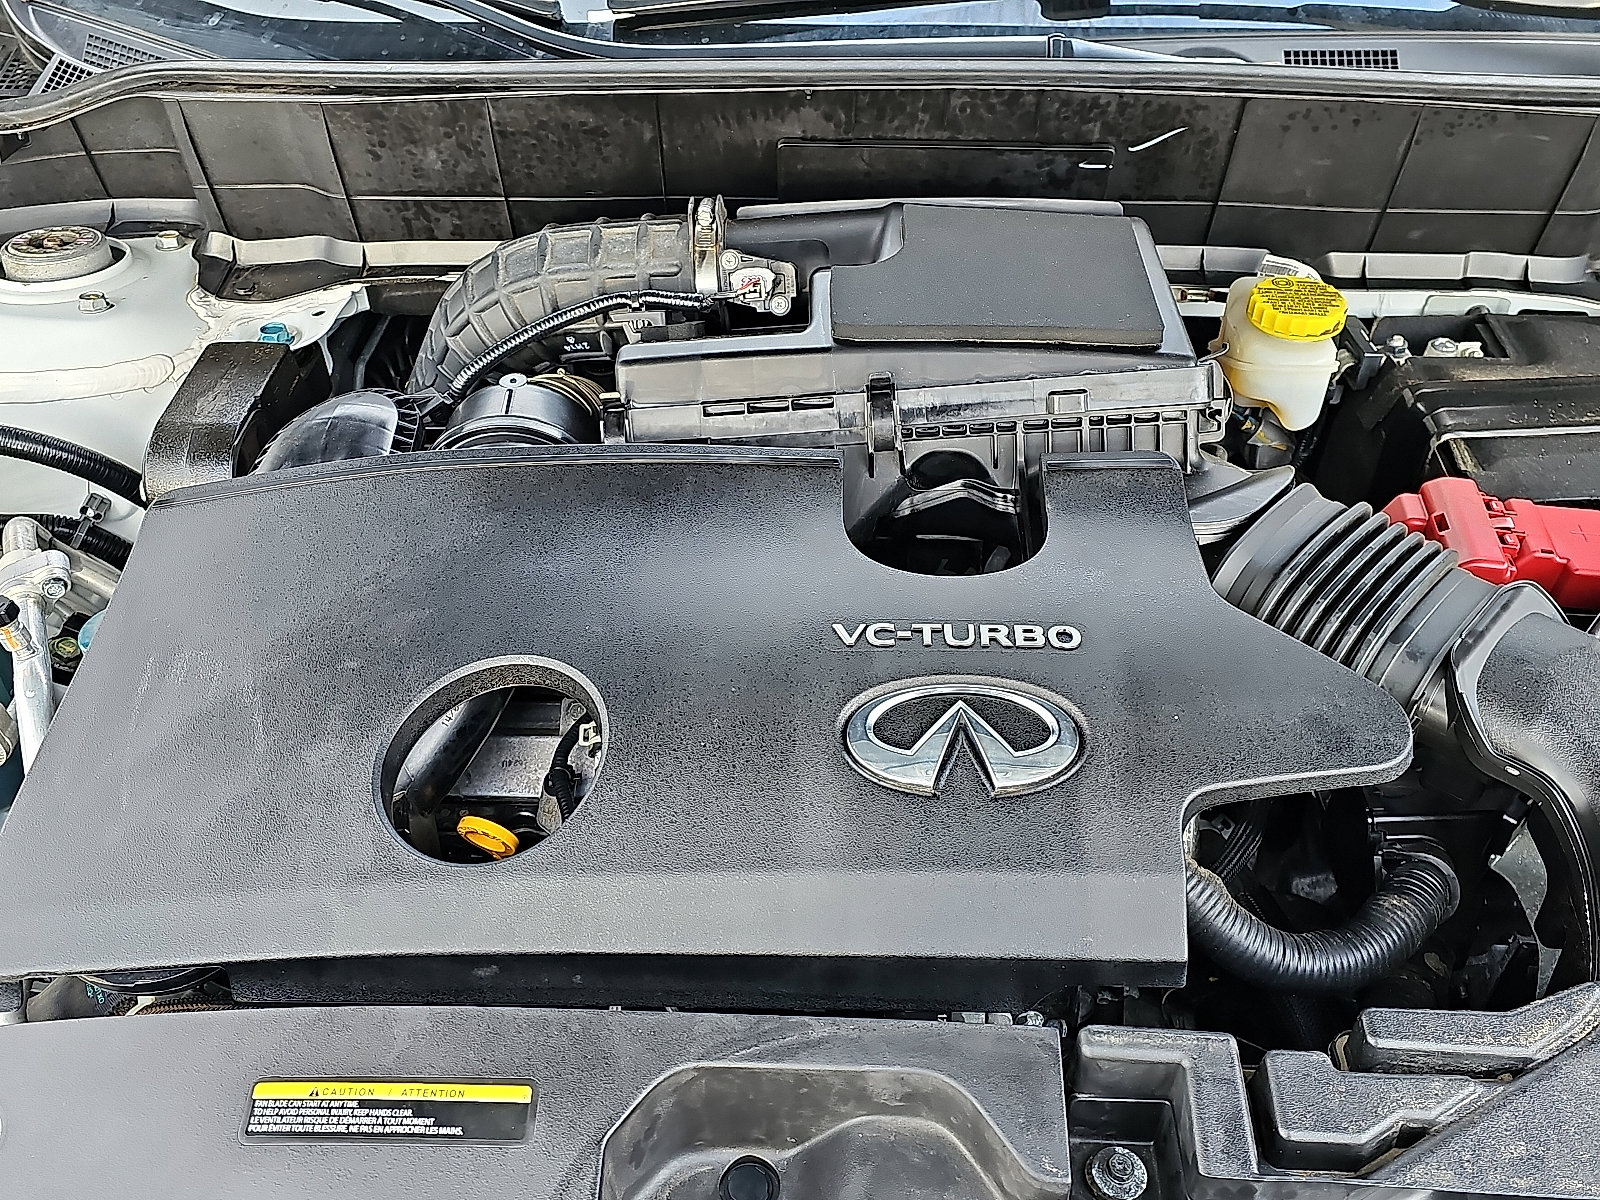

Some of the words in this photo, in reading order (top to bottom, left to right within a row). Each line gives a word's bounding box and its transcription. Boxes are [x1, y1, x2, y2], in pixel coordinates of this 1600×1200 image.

[831, 622, 1083, 650] VC-TURBO
[322, 1087, 376, 1097] CAUTION
[387, 1088, 393, 1097] /
[400, 1088, 466, 1098] ATTENTION
[254, 1100, 269, 1108] FAN
[268, 1100, 288, 1108] BLADE
[287, 1100, 303, 1108] CAN
[301, 1100, 323, 1108] START
[320, 1100, 332, 1108] AT
[253, 1107, 263, 1116] TO
[262, 1107, 280, 1116] HELP
[278, 1108, 299, 1116] AVOID
[298, 1108, 330, 1116] PERSONAL
[353, 1108, 370, 1117] KEEP
[369, 1108, 393, 1117] HANDS
[250, 1115, 261, 1124] LE
[259, 1116, 304, 1124] VENTILATEUR
[303, 1116, 331, 1125] RISQUE
[329, 1116, 341, 1125] DE
[382, 1117, 404, 1126] TOUT
[247, 1124, 269, 1133] POUR
[290, 1124, 316, 1133] TOUTE
[348, 1125, 360, 1134] NE
[359, 1125, 375, 1134] PAS
[373, 1126, 386, 1135] EN
[425, 1126, 440, 1136] LES
